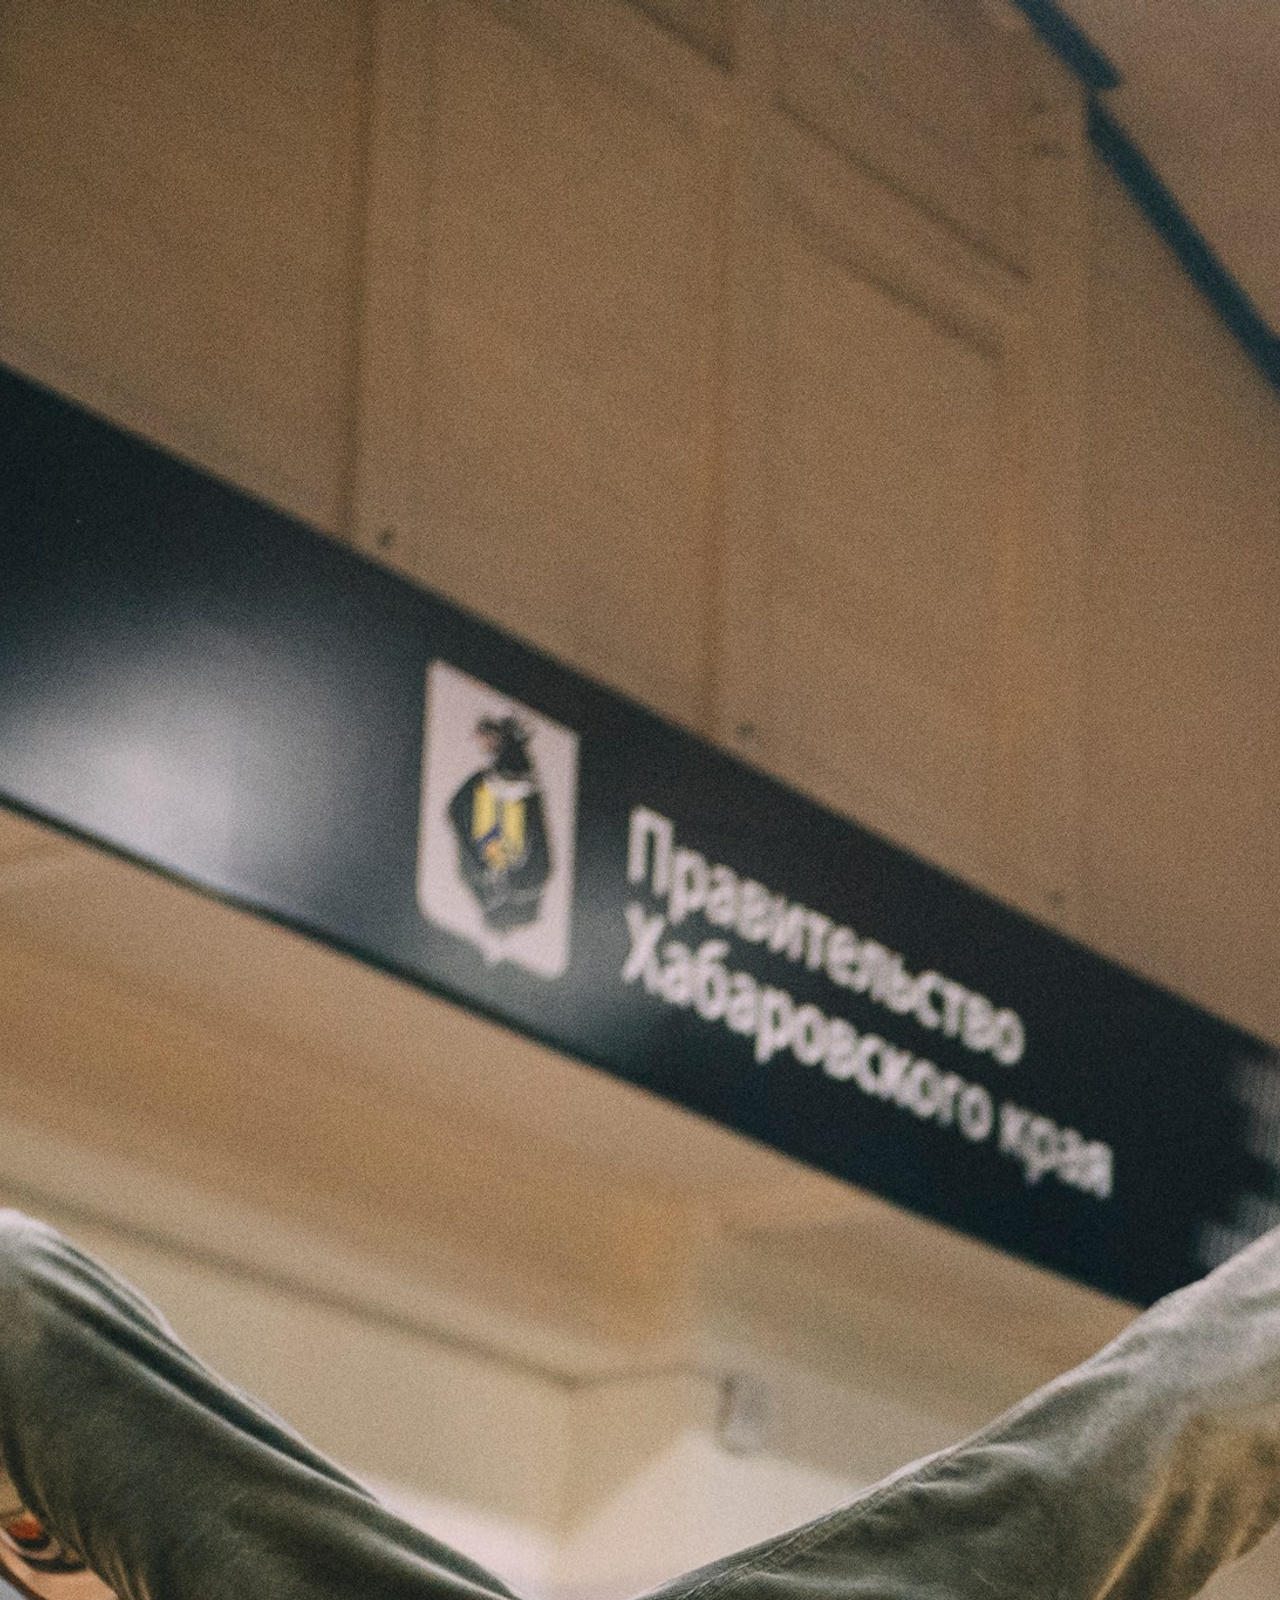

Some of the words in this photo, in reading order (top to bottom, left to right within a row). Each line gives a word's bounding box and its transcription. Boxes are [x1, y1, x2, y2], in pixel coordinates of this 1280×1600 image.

[621, 902, 994, 1142] Хабаровского
[999, 1101, 1114, 1200] края
[627, 804, 1027, 1066] Правительство
